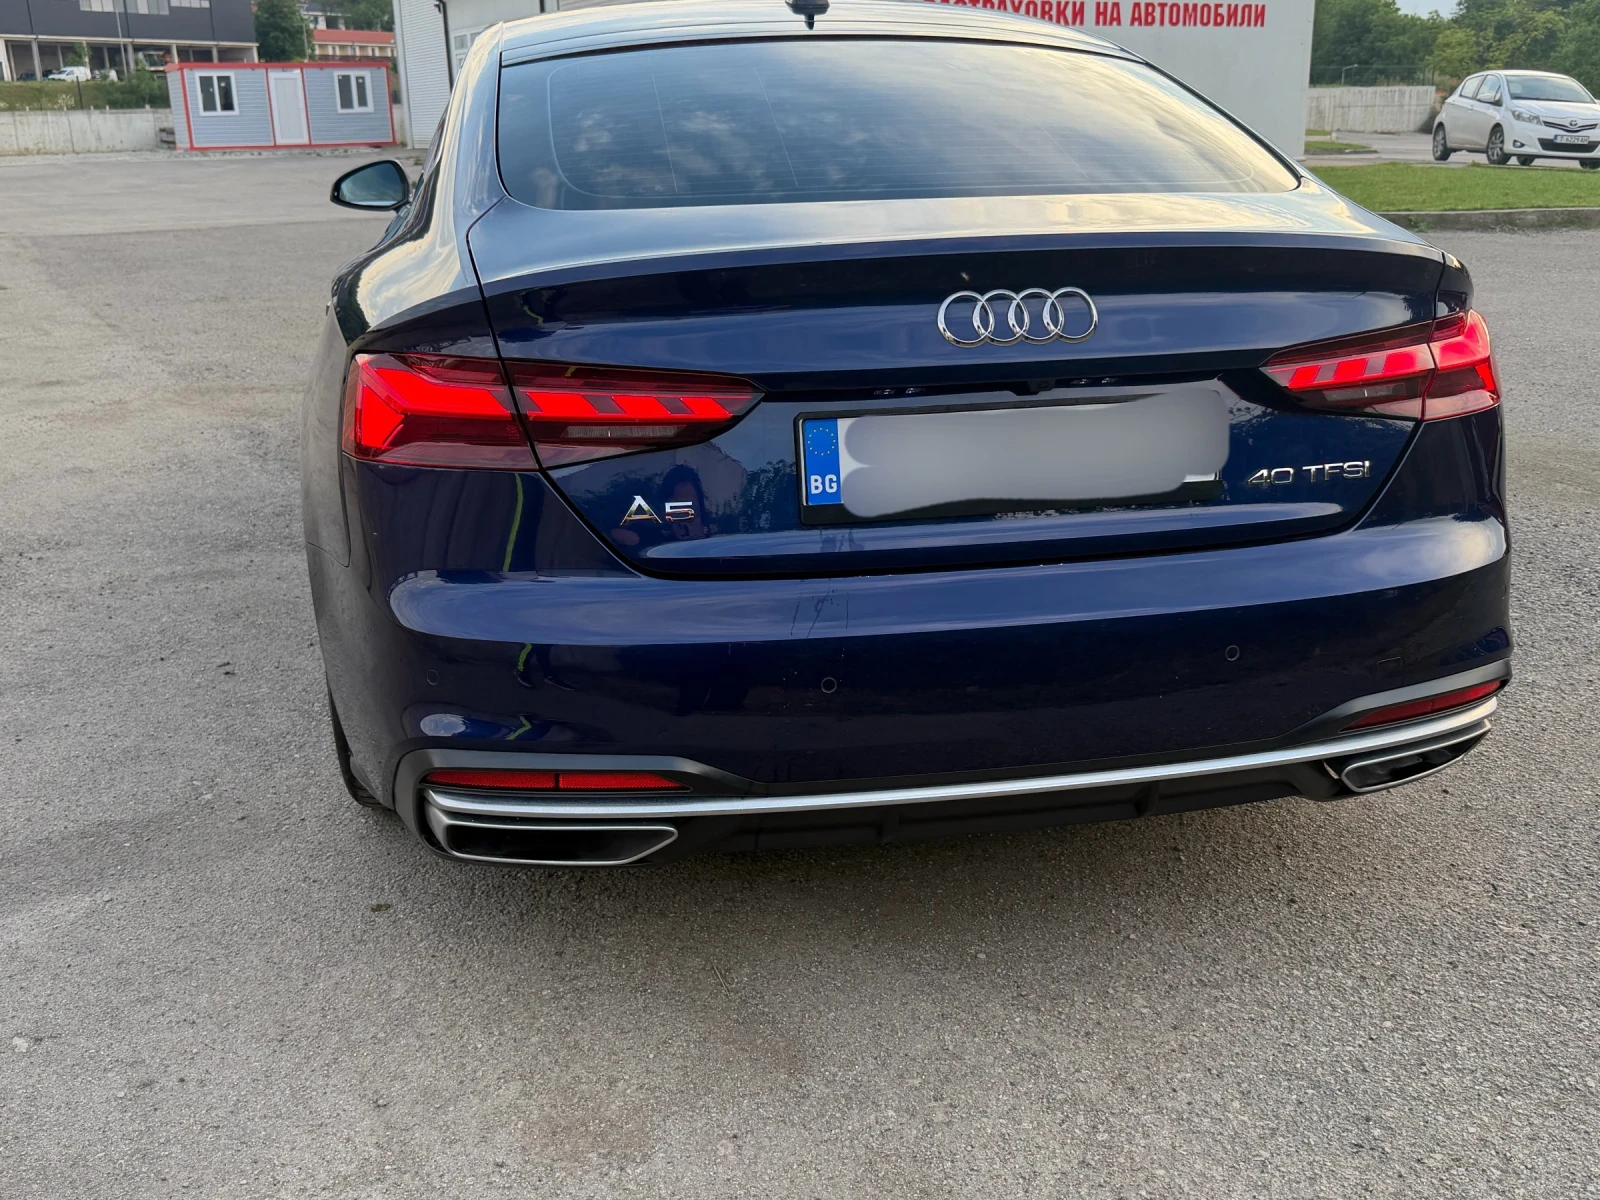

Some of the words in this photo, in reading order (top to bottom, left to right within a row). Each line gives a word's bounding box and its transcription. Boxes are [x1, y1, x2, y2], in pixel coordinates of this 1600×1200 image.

[1095, 2, 1122, 26] НА
[1129, 2, 1266, 27] АВТОМОБИЛИ
[810, 474, 838, 494] BG
[1247, 467, 1294, 488] 40
[1302, 460, 1370, 483] TFSI
[620, 495, 695, 526] A5
